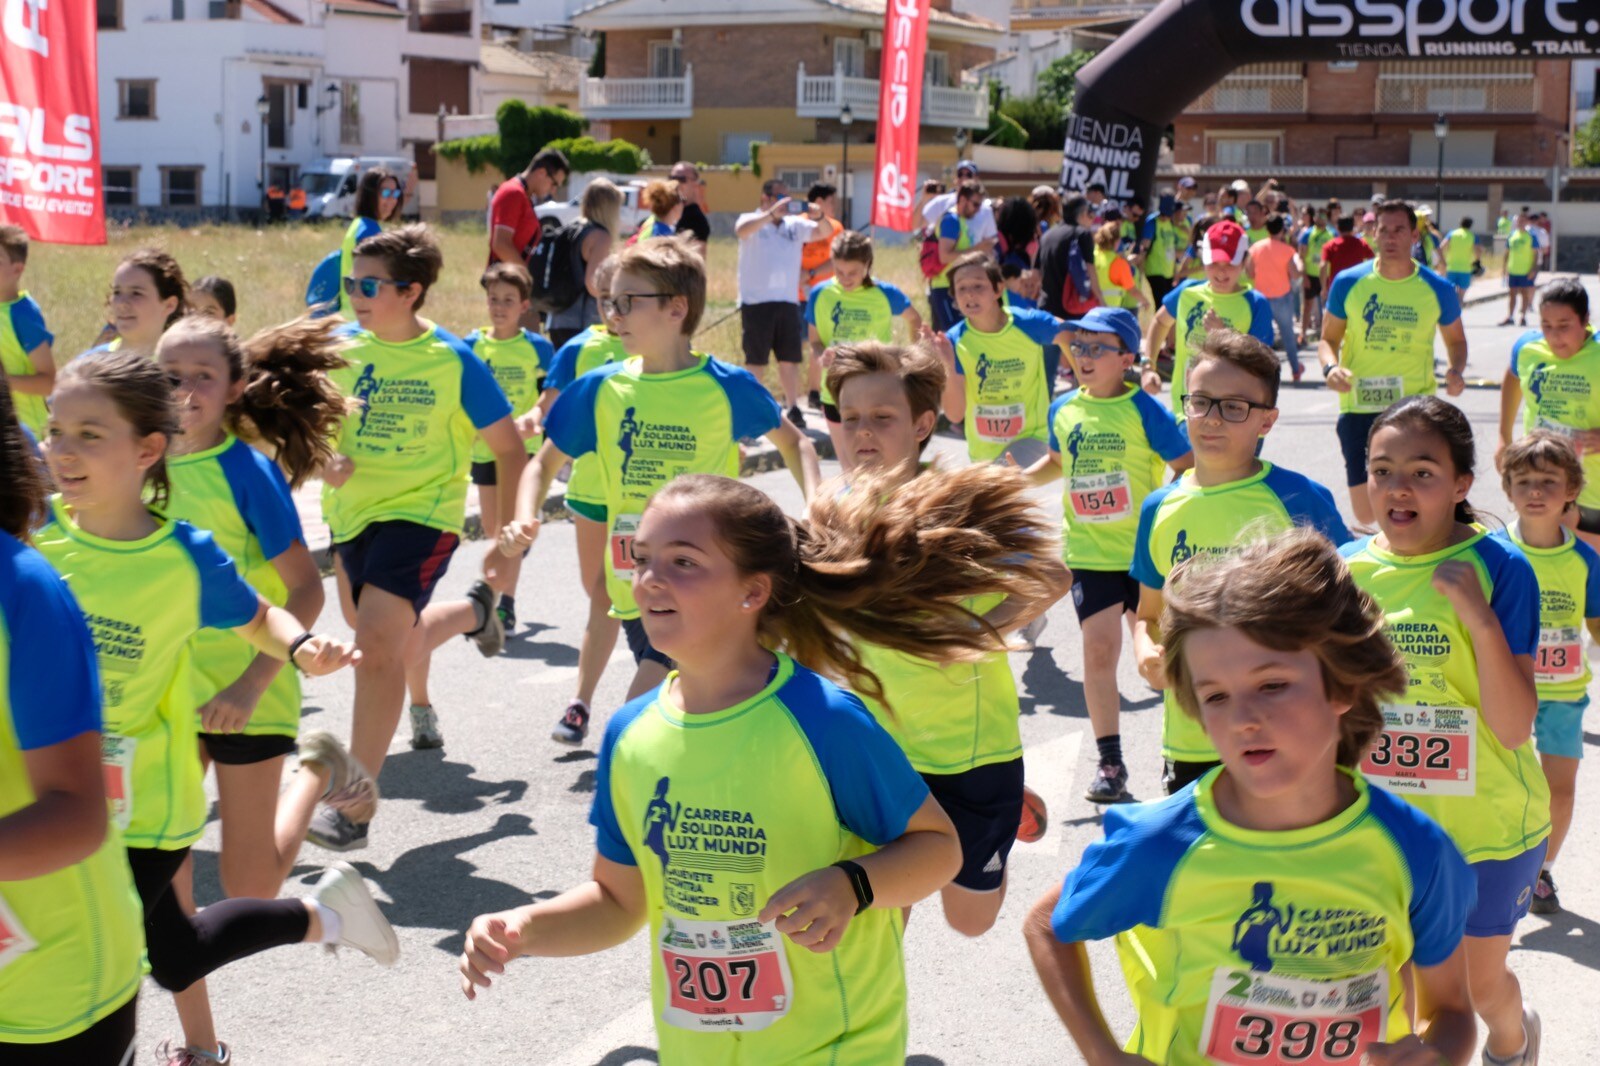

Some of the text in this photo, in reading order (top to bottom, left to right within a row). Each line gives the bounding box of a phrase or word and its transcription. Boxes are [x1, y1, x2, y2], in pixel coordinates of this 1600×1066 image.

[1336, 43, 1405, 57] TIENDA
[1424, 42, 1516, 56] RUNNING
[1532, 40, 1591, 55] TRAIL
[1066, 113, 1143, 149] TIENDA
[1062, 158, 1134, 198] TRAIL
[371, 396, 394, 404] LUX
[1362, 389, 1394, 402] 234
[645, 423, 690, 433] CARRERA
[987, 419, 1011, 432] 117
[633, 439, 697, 451] LUX MUNDI
[643, 431, 696, 442] SOLIDARIA
[1080, 491, 1115, 510] 154
[1371, 734, 1450, 769] 332
[1389, 780, 1417, 788] helvetia
[684, 807, 754, 824] CARRERA
[680, 821, 766, 840] SOLIDARIA
[667, 836, 766, 856] LUX MUNDI
[1296, 915, 1387, 939] SOLIDARIA
[1274, 929, 1387, 956] LUX MUNDI
[675, 958, 756, 1001] 207
[700, 1018, 733, 1026] helvetia
[1235, 1015, 1361, 1059] 398
